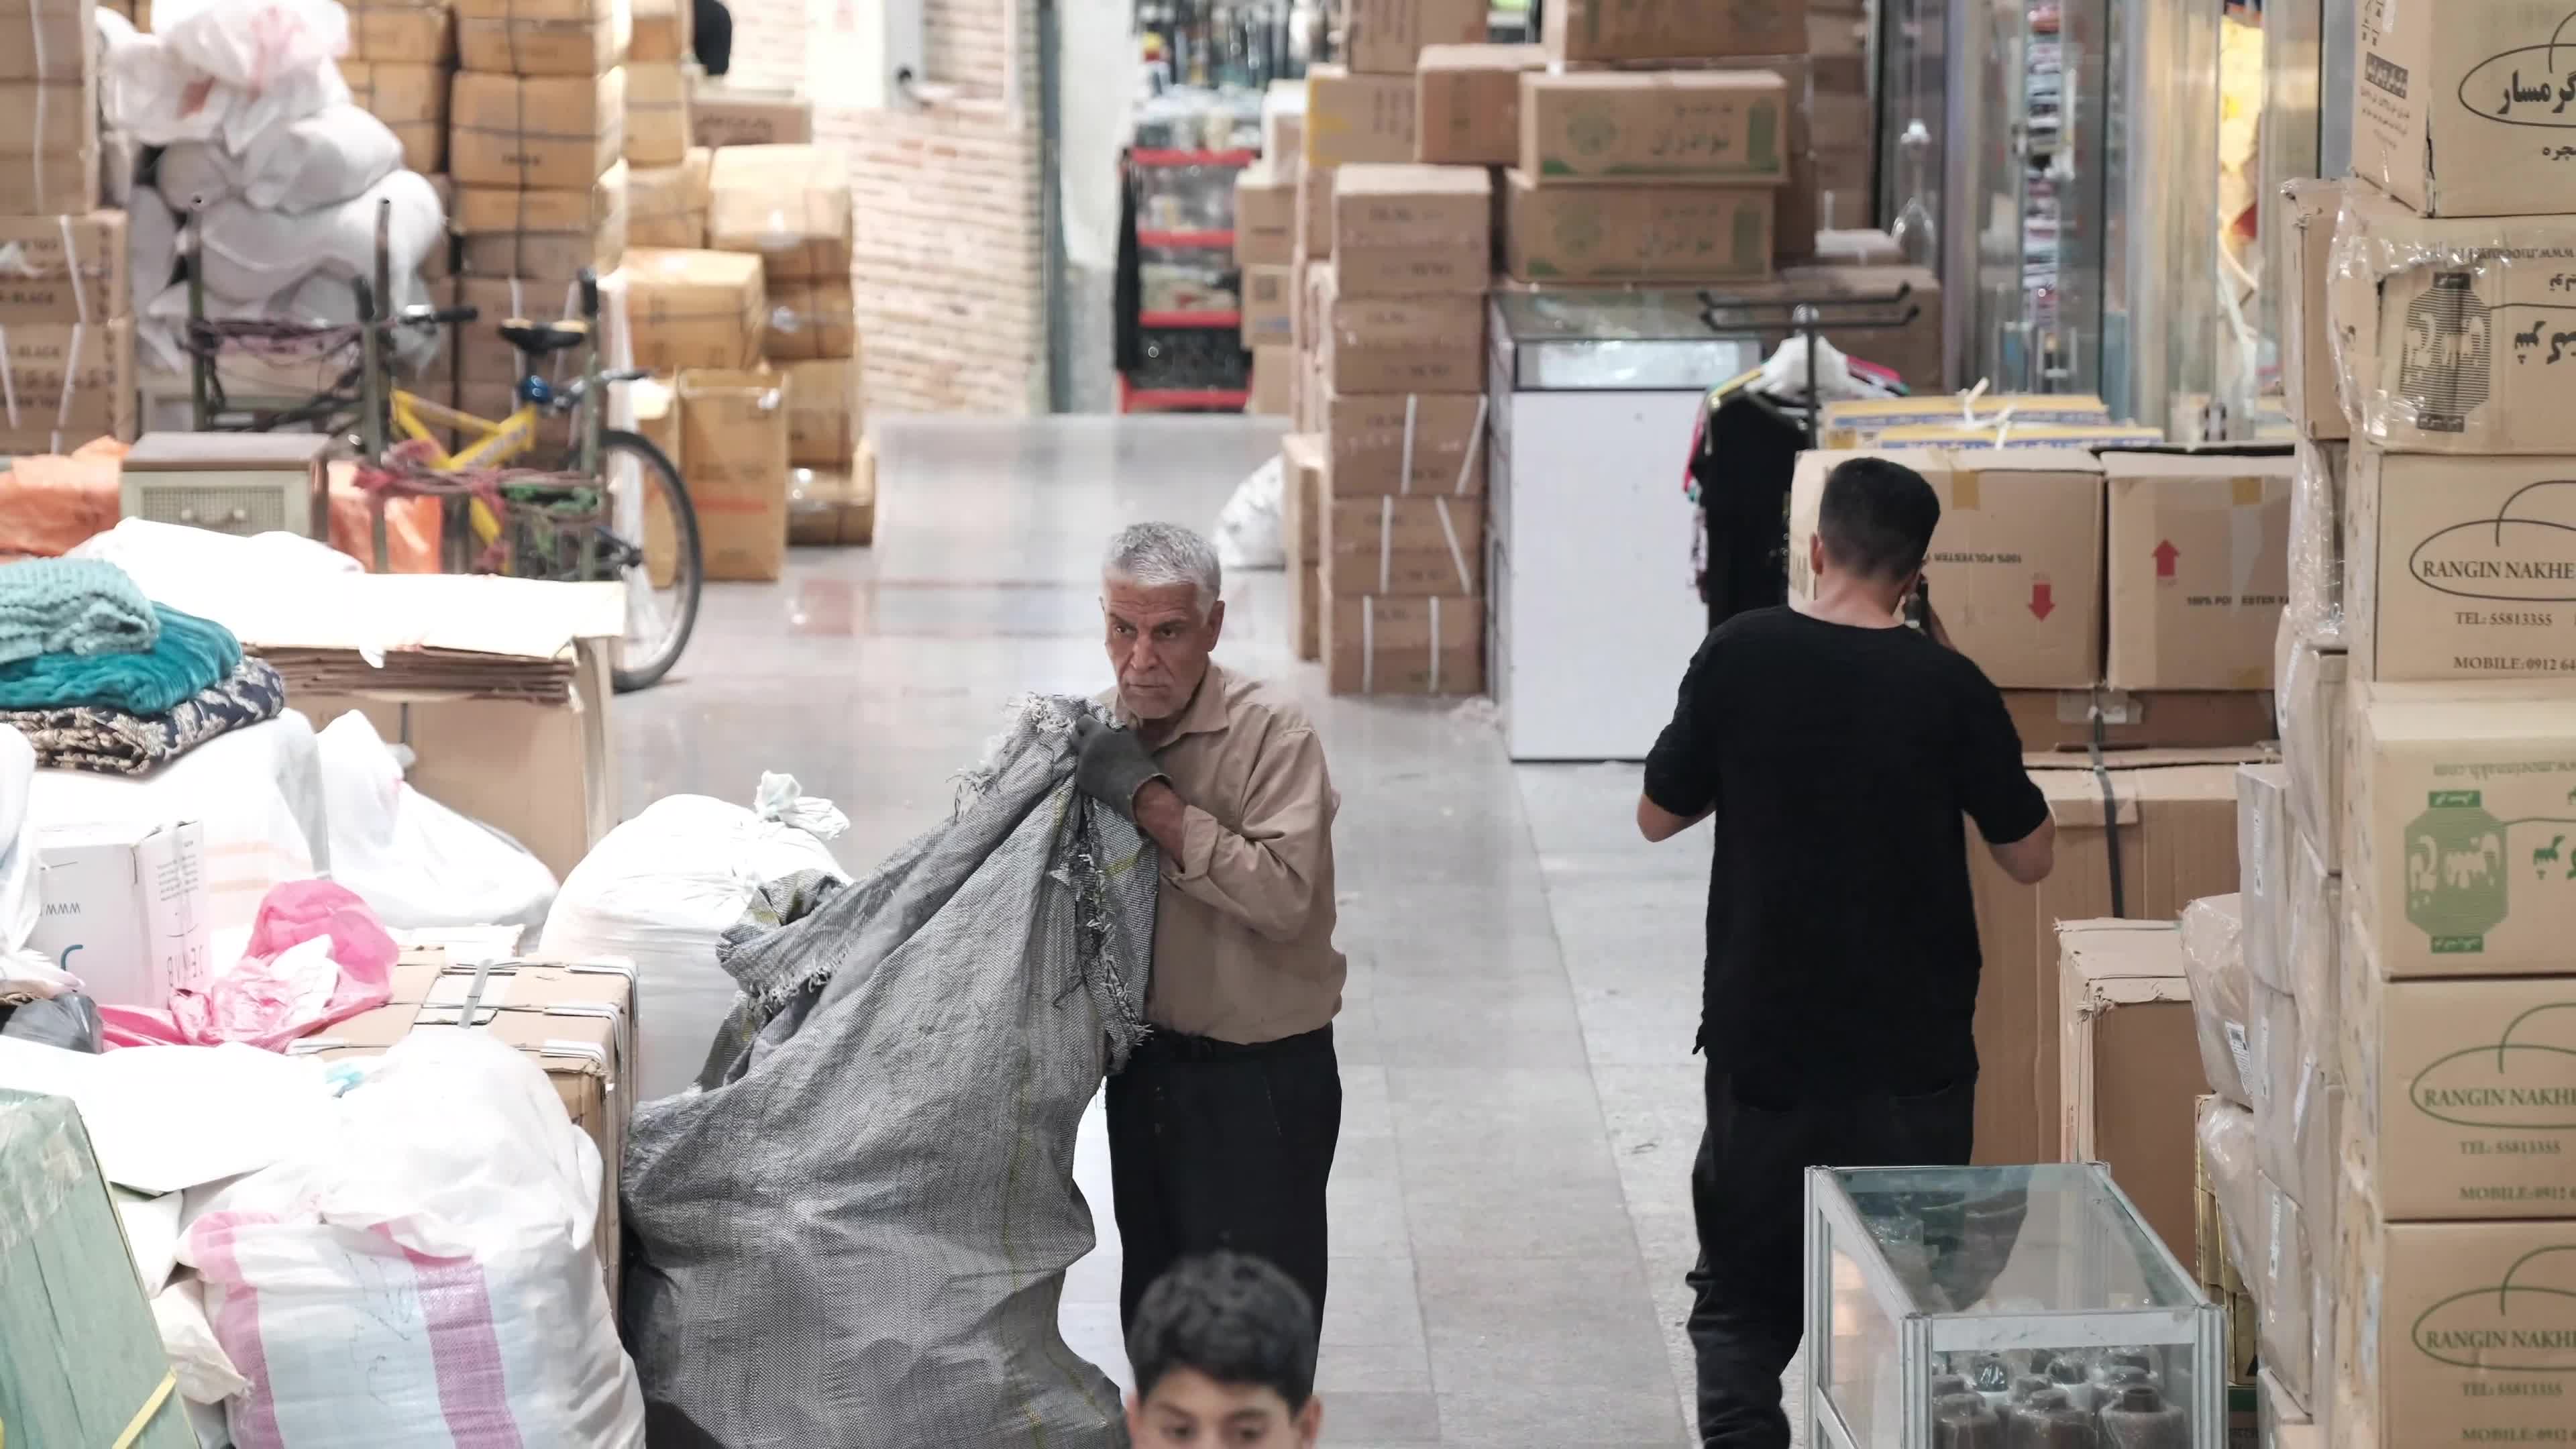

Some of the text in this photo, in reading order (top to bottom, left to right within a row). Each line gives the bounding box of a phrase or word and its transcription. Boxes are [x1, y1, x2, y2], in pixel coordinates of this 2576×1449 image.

[2422, 560, 2502, 578] RANGIN
[2455, 612, 2486, 625] TEL:
[2423, 1088, 2506, 1106] RANGIN
[2426, 1330, 2507, 1348] RANGIN
